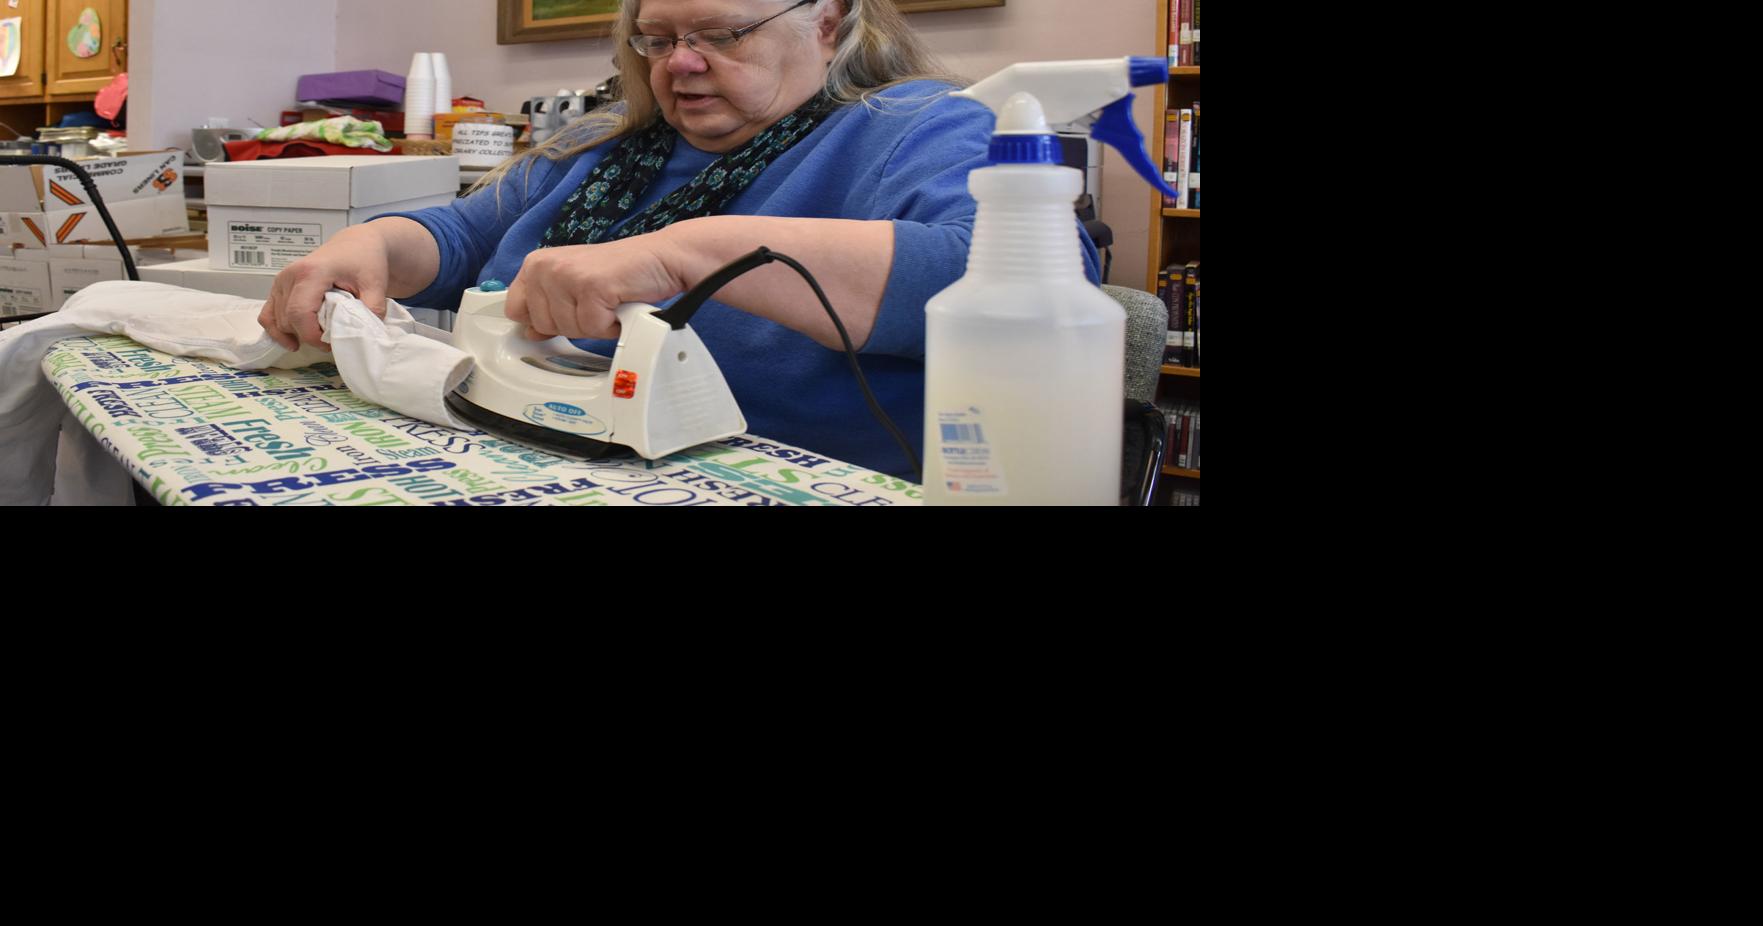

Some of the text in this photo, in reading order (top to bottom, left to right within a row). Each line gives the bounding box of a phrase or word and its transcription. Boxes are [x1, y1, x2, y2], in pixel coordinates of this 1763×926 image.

[221, 418, 316, 461] Fresh
[336, 445, 381, 465] Iron
[180, 457, 456, 502] PRESS
[387, 474, 466, 499] HOT
